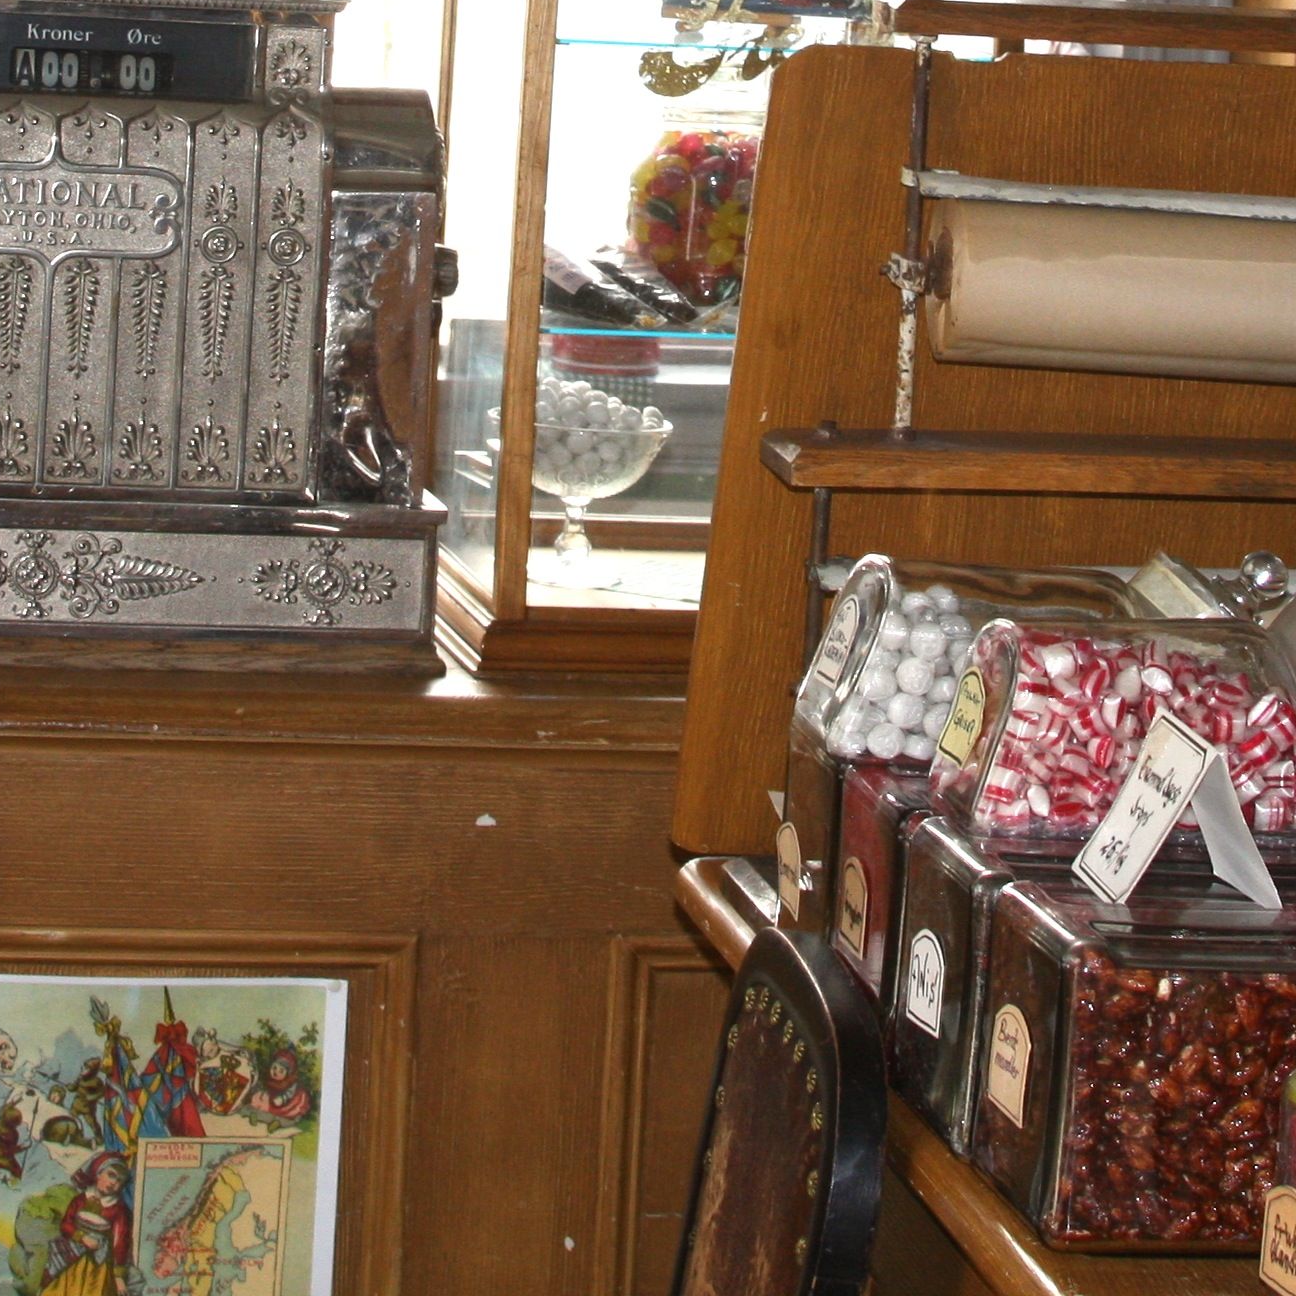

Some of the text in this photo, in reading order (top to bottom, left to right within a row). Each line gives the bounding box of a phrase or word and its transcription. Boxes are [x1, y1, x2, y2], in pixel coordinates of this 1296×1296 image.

[26, 22, 163, 47] Kroner Øre
[119, 53, 157, 91] 00
